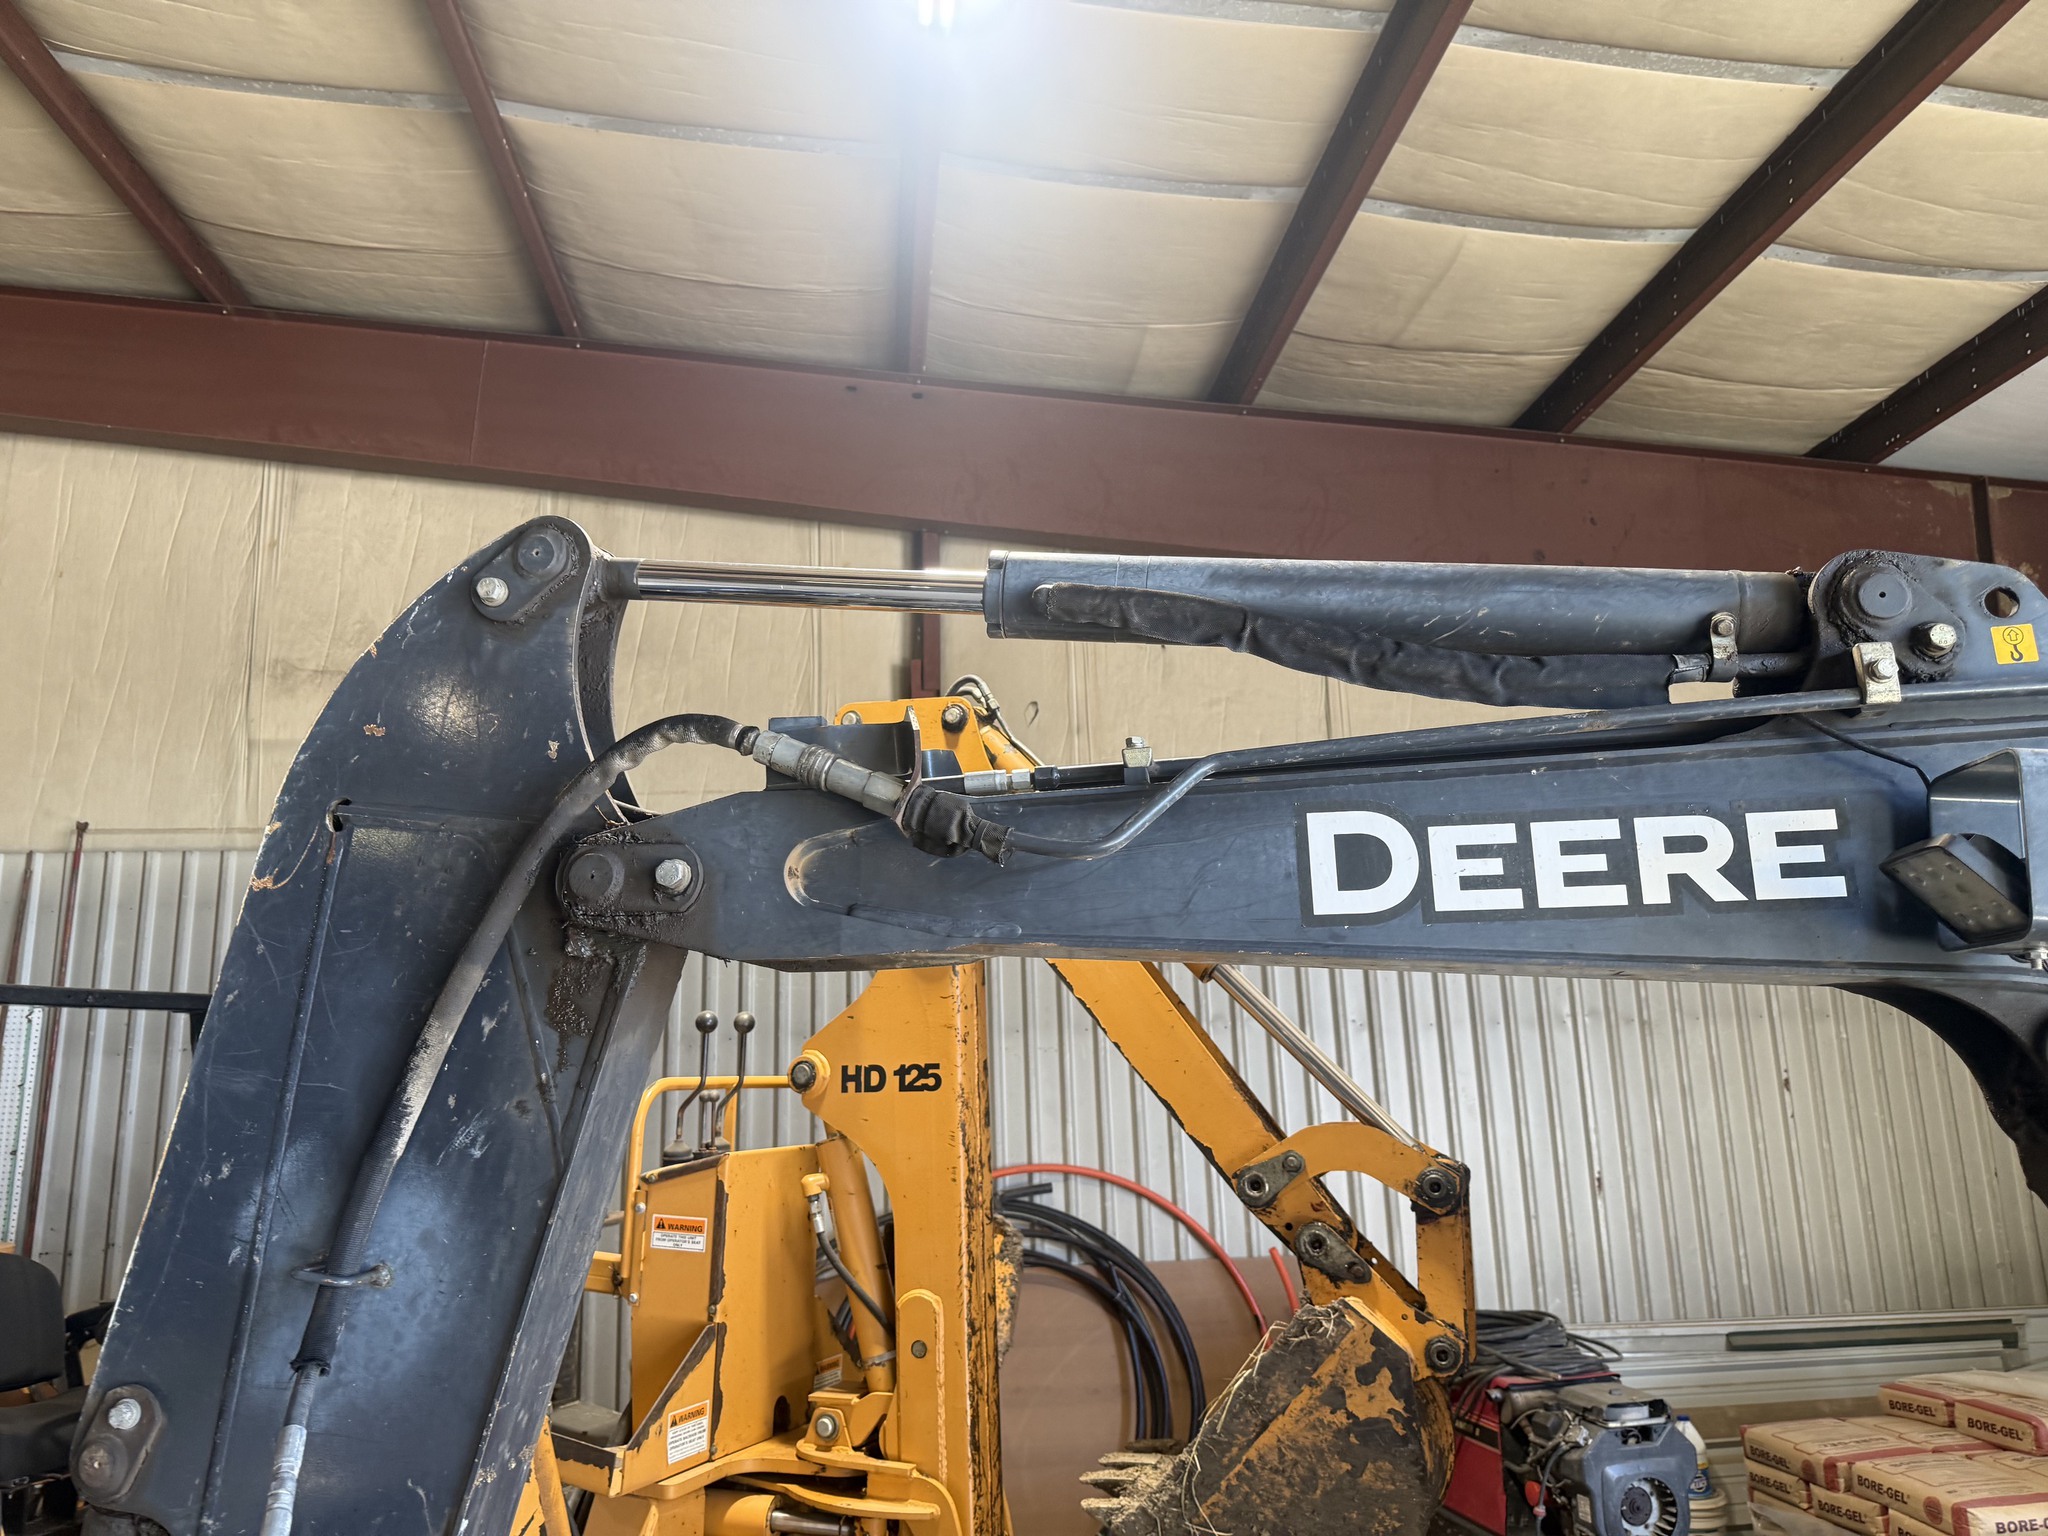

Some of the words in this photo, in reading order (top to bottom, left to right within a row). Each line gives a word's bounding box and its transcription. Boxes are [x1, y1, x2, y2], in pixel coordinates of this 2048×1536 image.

[1306, 809, 1848, 915] DEERE
[841, 1064, 886, 1093] HD
[893, 1063, 942, 1092] 125
[667, 1223, 703, 1233] WARNING
[678, 1407, 705, 1423] WARNING
